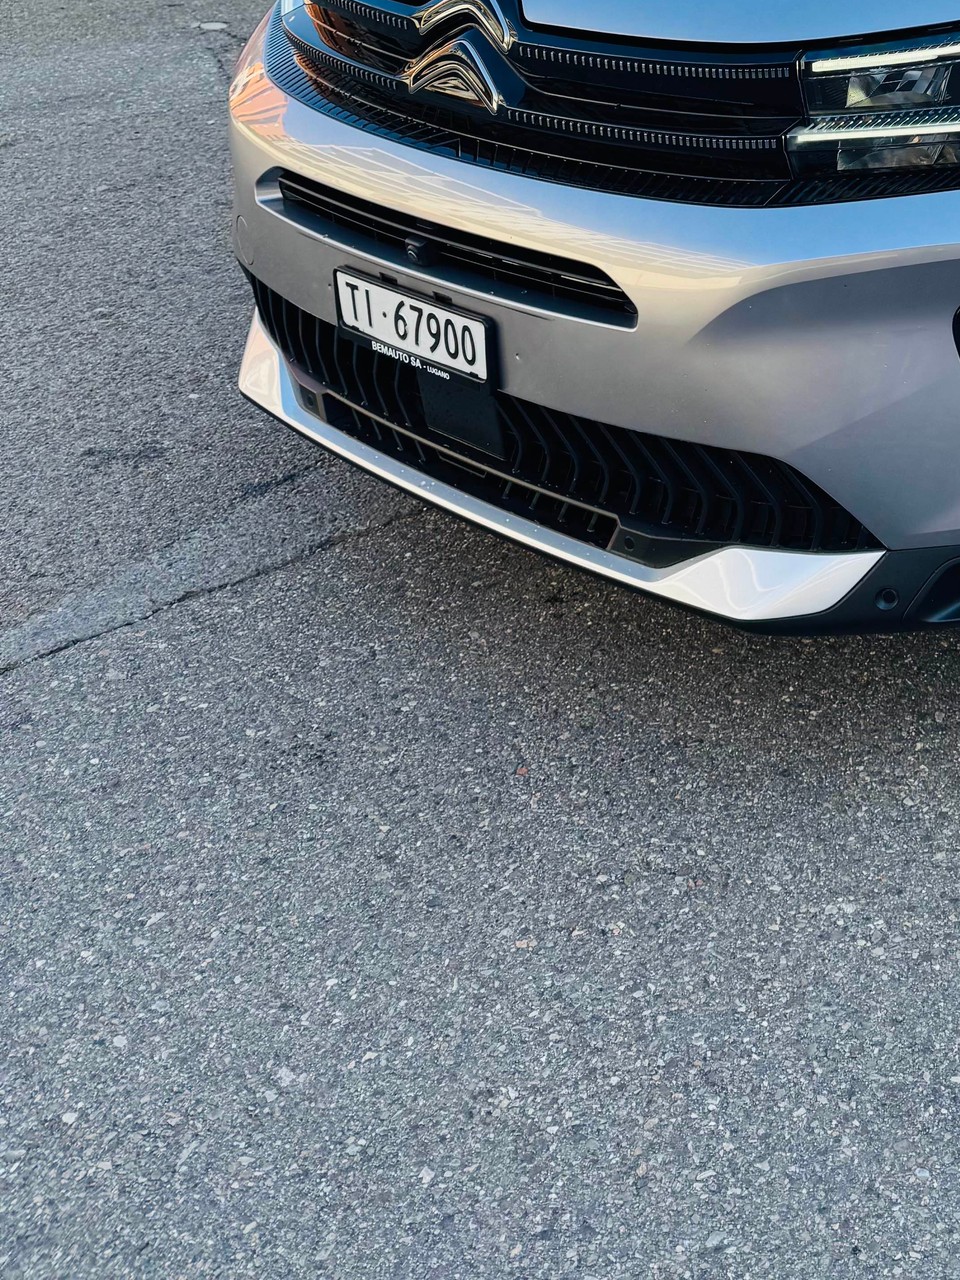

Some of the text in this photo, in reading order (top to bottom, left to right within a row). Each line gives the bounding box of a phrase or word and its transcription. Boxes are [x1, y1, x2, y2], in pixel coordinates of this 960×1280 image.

[371, 340, 410, 364] BEMAUTO
[410, 357, 422, 370] SA
[427, 365, 450, 380] LUGANO
